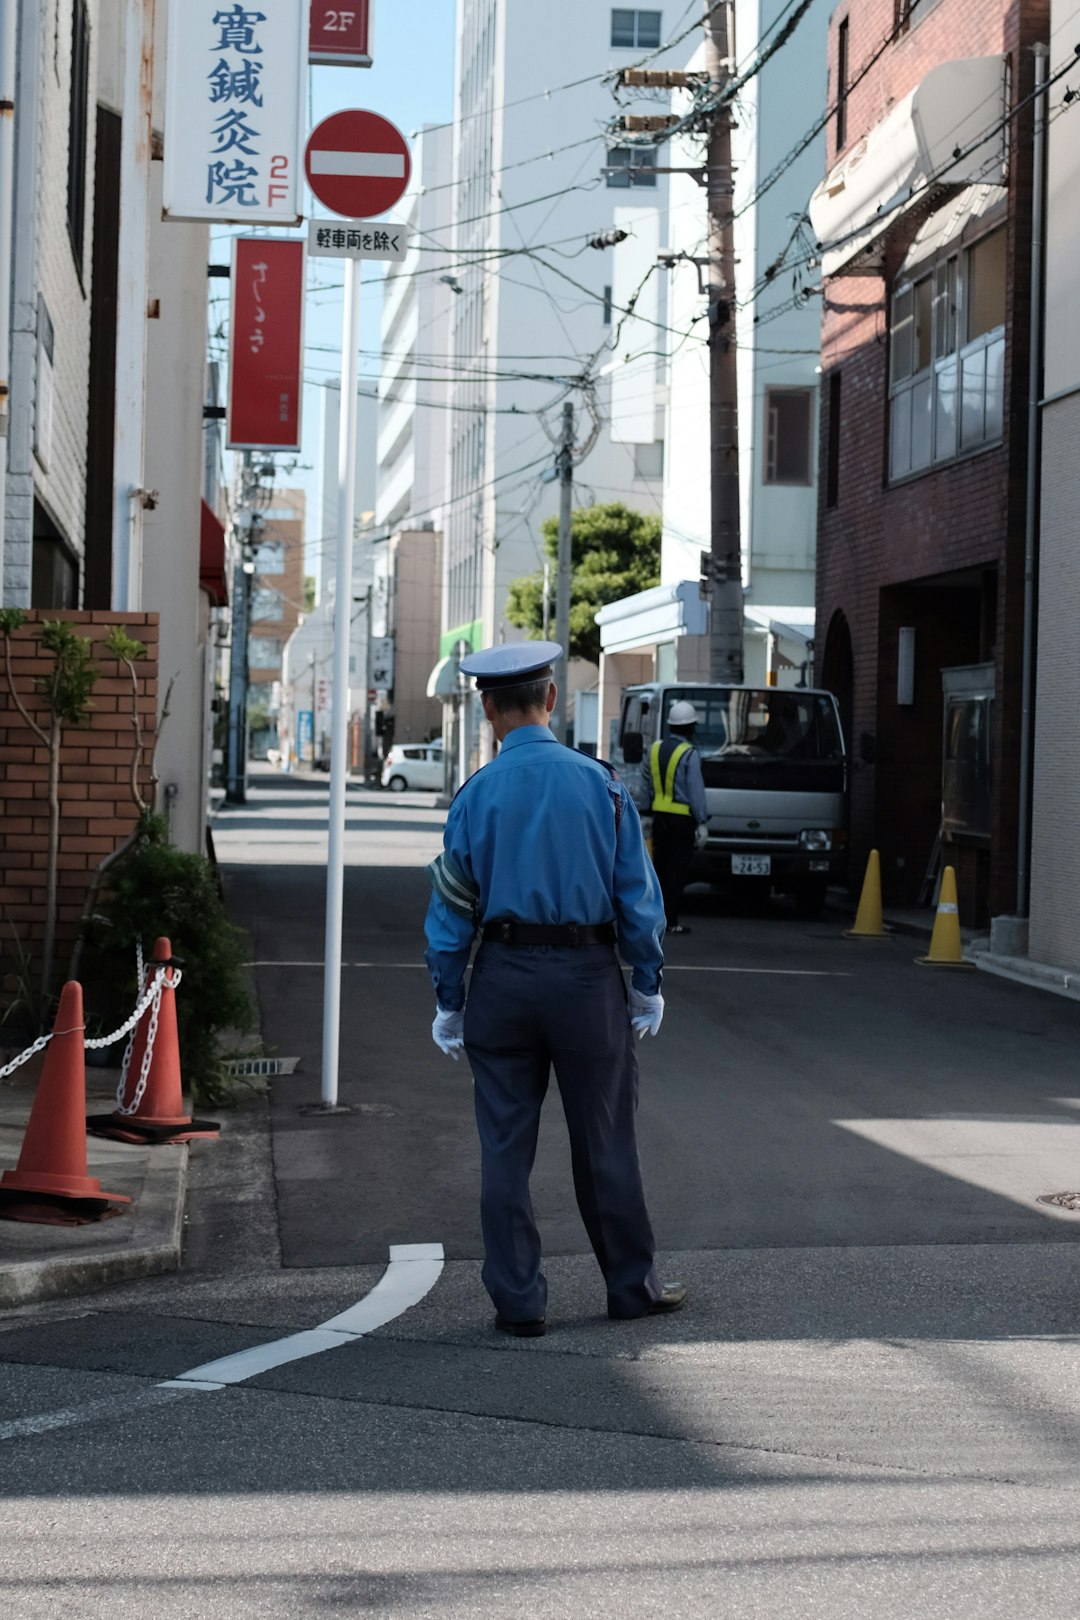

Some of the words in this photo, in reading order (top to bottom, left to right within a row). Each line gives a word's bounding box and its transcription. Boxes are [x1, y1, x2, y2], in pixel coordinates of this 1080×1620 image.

[322, 10, 356, 32] 2F
[267, 155, 289, 208] 2F
[316, 227, 400, 252] 軽車両を除く
[740, 862, 769, 874] 24-53
